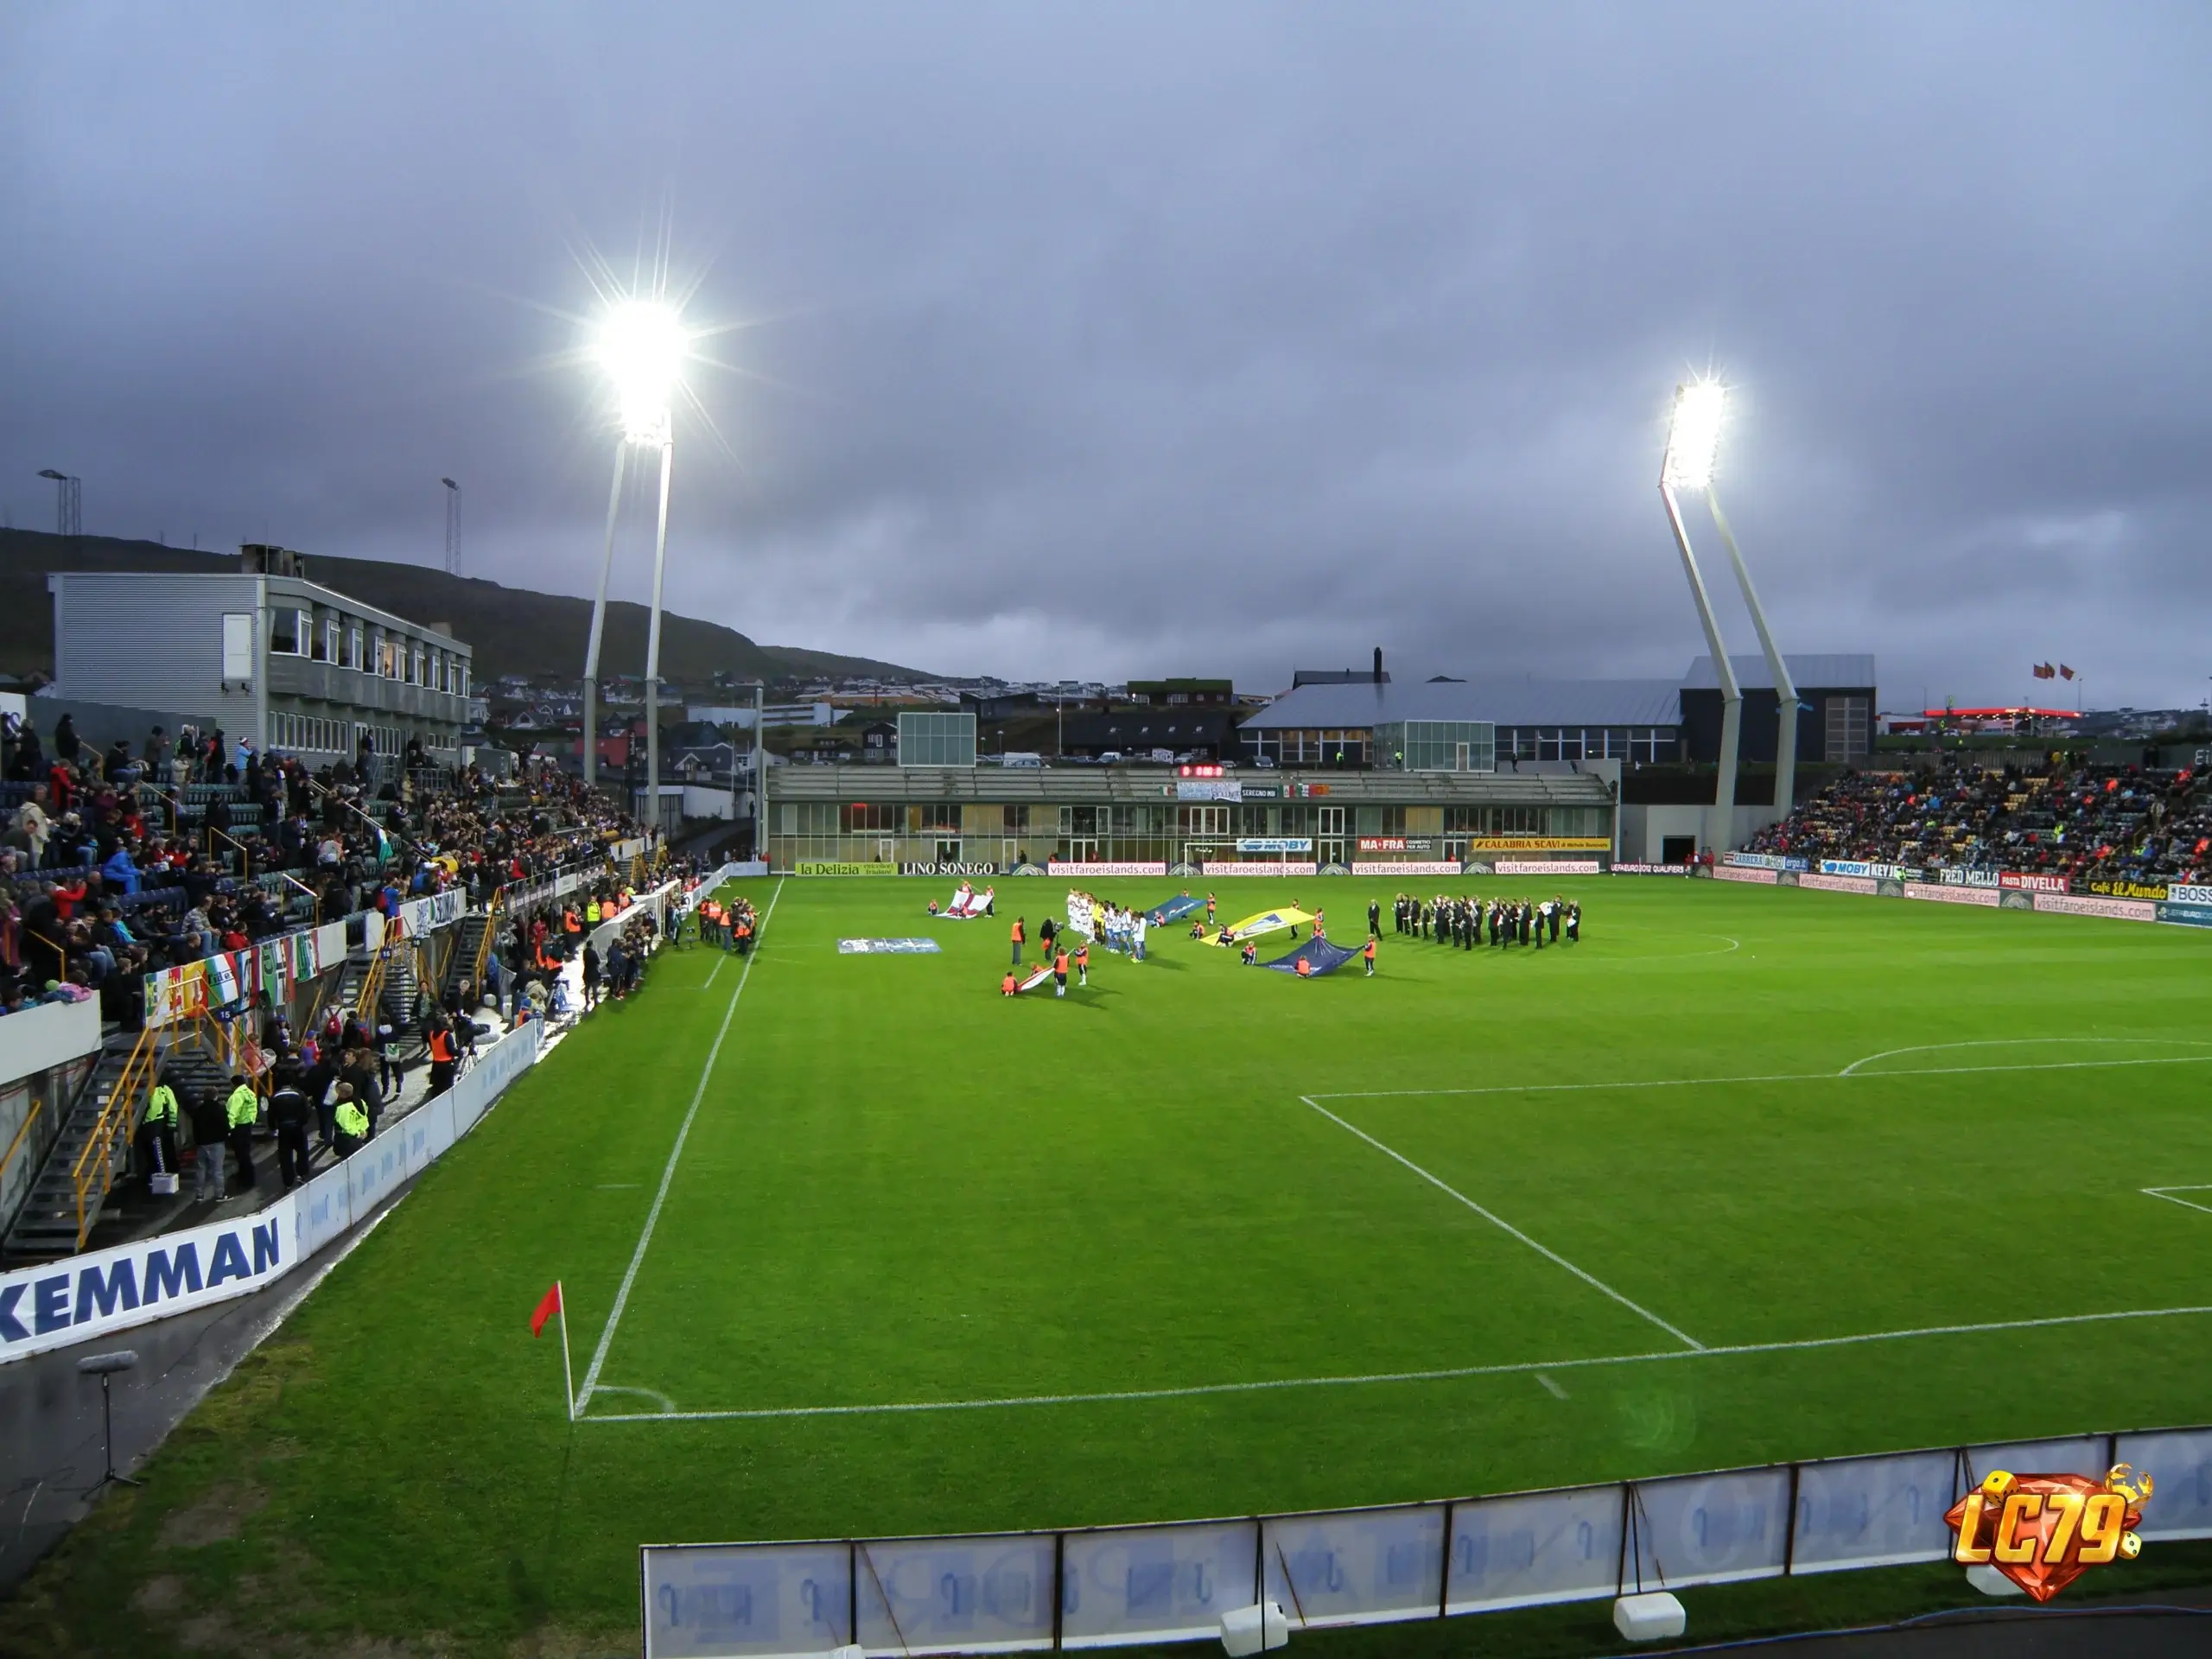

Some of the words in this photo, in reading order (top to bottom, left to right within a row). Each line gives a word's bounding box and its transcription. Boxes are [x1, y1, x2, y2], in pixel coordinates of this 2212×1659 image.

[1264, 841, 1310, 850] MOBY
[1484, 840, 1531, 849] CALABRIA
[800, 863, 812, 875] la
[816, 863, 860, 875] Delizia
[904, 862, 936, 874] LINO
[939, 862, 994, 874] SONEGO
[1050, 864, 1164, 874] visitfaroeislands.com
[1205, 864, 1315, 874] visitfaroeislands.com
[1354, 864, 1459, 874] visitfaroeislands.com
[1497, 863, 1598, 873] visitfaroeislands.com
[1652, 865, 1684, 874] QUALIFIERS
[1837, 862, 1868, 875] MOBY
[1871, 863, 1889, 877] KEY
[1939, 868, 1963, 883] FRED
[1965, 870, 1999, 887] MELLO
[2001, 875, 2020, 887] PASTA
[2020, 875, 2064, 891] DIVELLA
[1906, 886, 1998, 904] sitfaroeislands.com
[2112, 881, 2125, 896] El
[2126, 883, 2168, 899] Mundo
[2036, 897, 2152, 918] visitfaroeislands.com
[220, 1010, 231, 1019] 15
